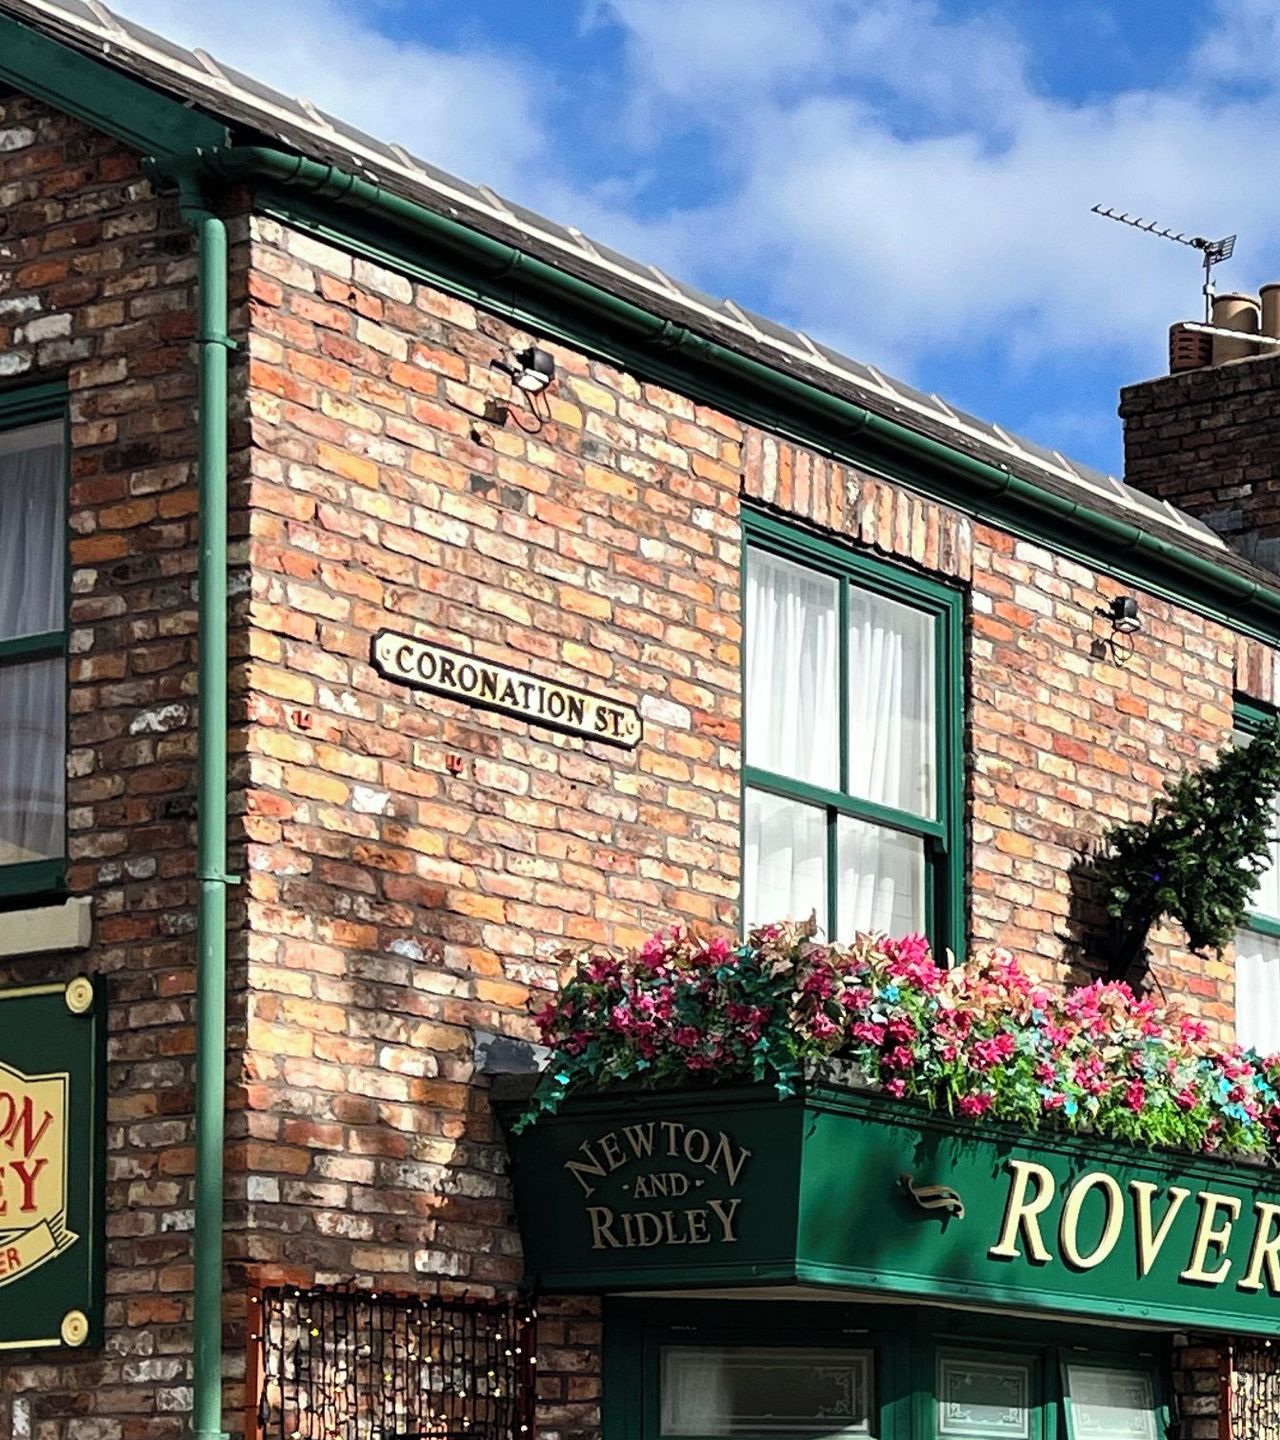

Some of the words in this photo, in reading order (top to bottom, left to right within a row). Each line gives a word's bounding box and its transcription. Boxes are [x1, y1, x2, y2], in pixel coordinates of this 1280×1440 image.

[396, 644, 585, 725] CORONATION
[594, 706, 625, 738] ST.
[564, 1121, 751, 1198] NEWTON
[633, 1172, 688, 1199] AND
[585, 1198, 742, 1249] RIDLEY
